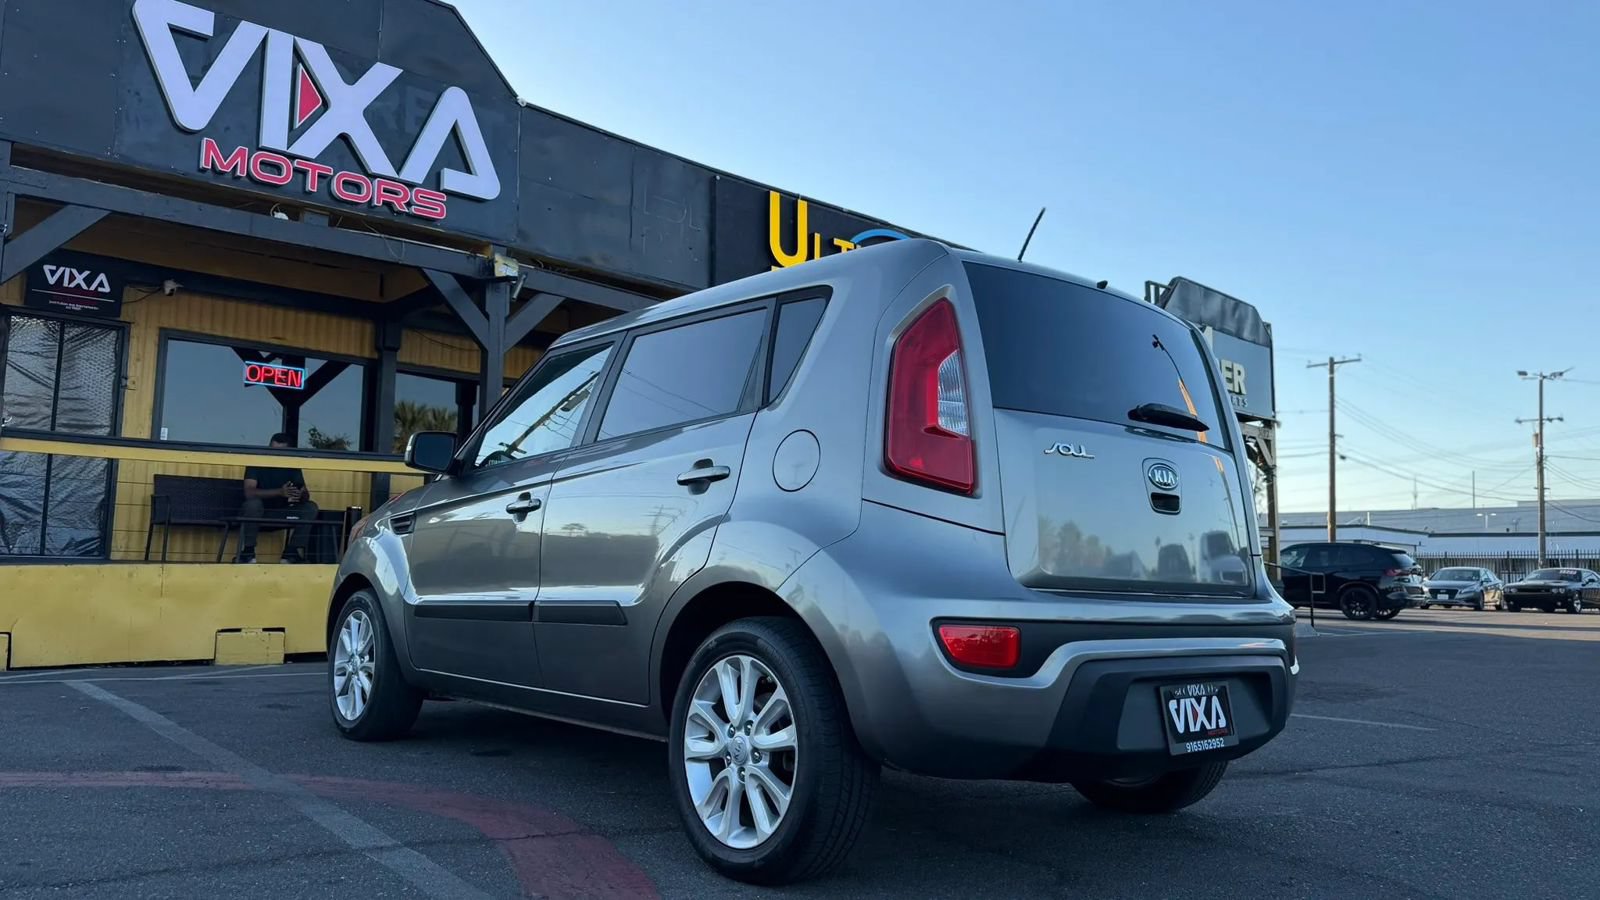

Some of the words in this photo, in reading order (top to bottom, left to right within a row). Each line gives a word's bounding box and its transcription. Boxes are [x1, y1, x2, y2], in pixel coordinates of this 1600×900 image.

[132, 0, 500, 200] VIXA
[201, 137, 447, 220] MOTORS
[769, 190, 861, 268] ULT
[43, 264, 111, 293] VIXA
[246, 364, 302, 387] OPEN
[1219, 359, 1247, 395] ER
[1153, 468, 1176, 485] KIA
[1187, 684, 1206, 697] VIXA
[1168, 695, 1227, 734] VIXA
[1185, 738, 1225, 752] 9165162952
